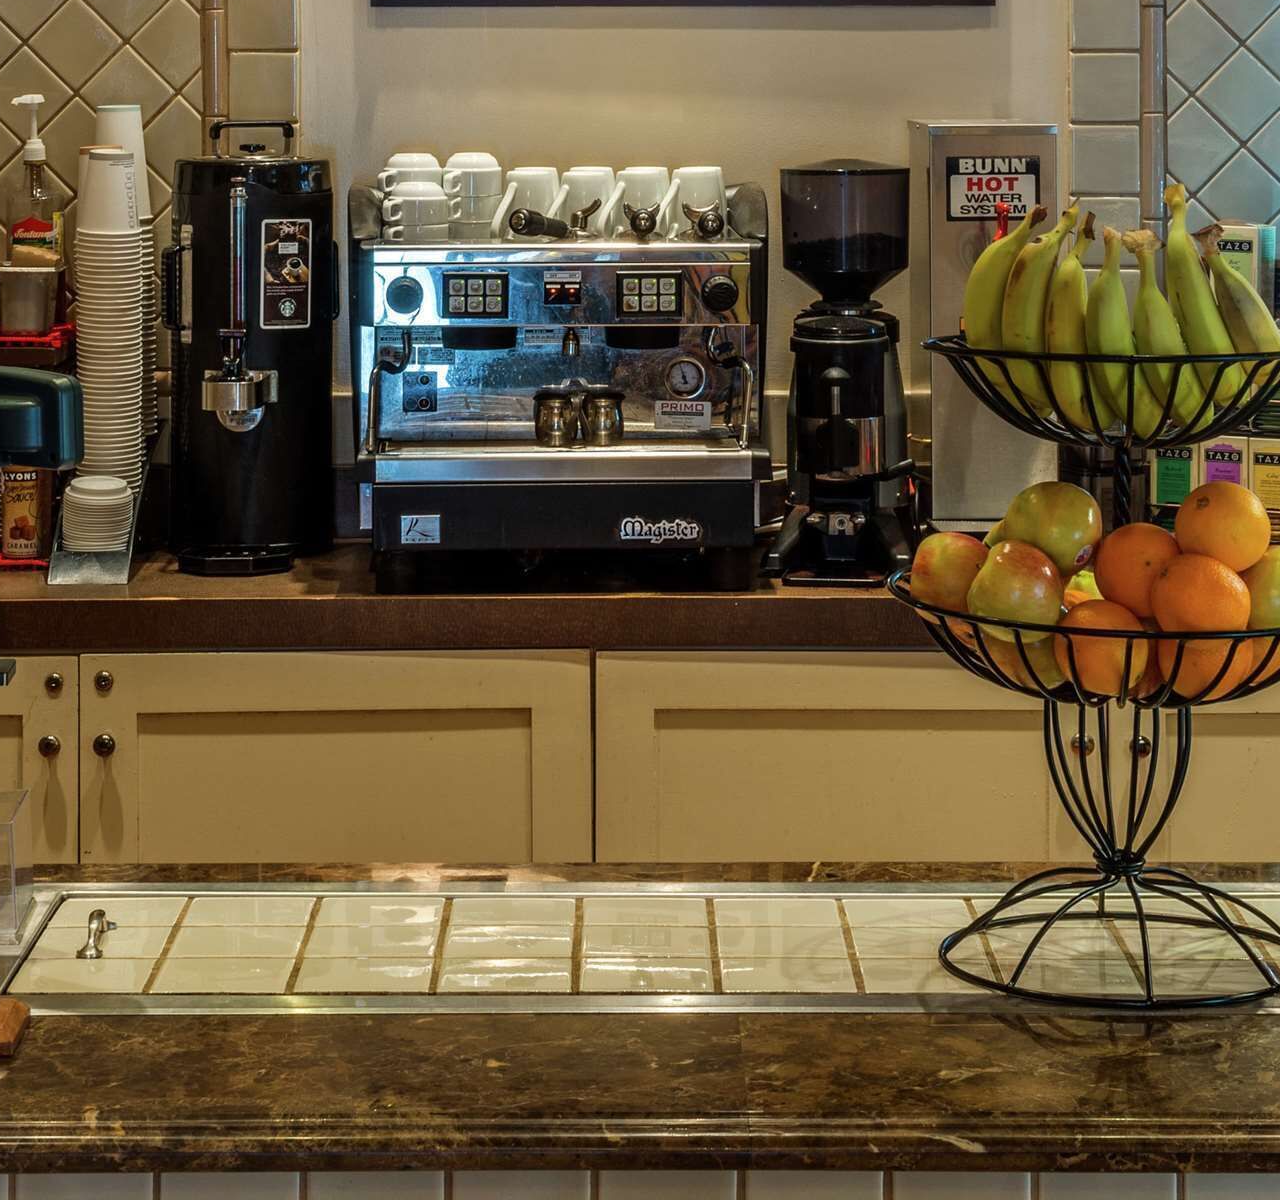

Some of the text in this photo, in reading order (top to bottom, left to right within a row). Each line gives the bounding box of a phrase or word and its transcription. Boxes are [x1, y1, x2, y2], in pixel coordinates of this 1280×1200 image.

[958, 158, 1027, 174] BUNN
[966, 176, 1019, 192] HOT
[964, 193, 1022, 203] WATER
[1219, 240, 1251, 251] TAZO
[661, 402, 705, 412] PRIMO
[1158, 449, 1190, 458] TAZO
[1208, 451, 1239, 461] TAZO
[5, 472, 37, 481] LYONS
[621, 516, 699, 543] Magister
